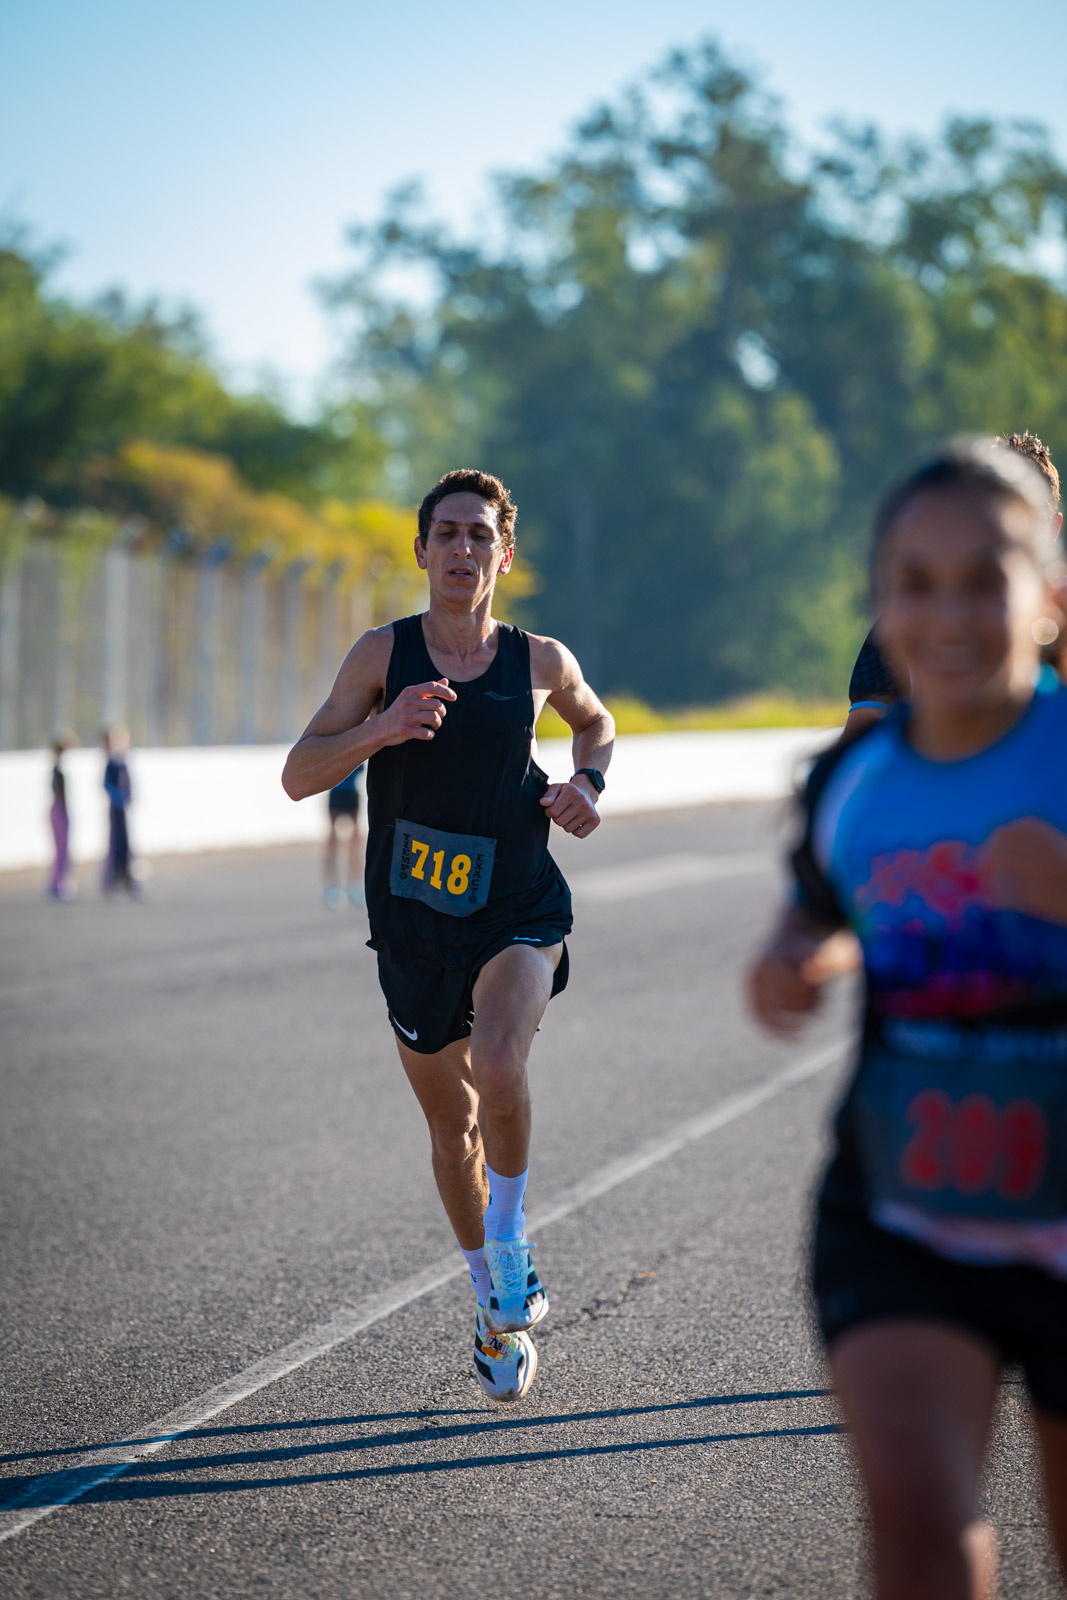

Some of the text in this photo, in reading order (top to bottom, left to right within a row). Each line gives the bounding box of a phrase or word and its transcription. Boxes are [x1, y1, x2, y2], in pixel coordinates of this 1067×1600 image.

[399, 833, 411, 879] TIEMPO
[411, 840, 471, 895] 718
[469, 854, 484, 903] EXACTO
